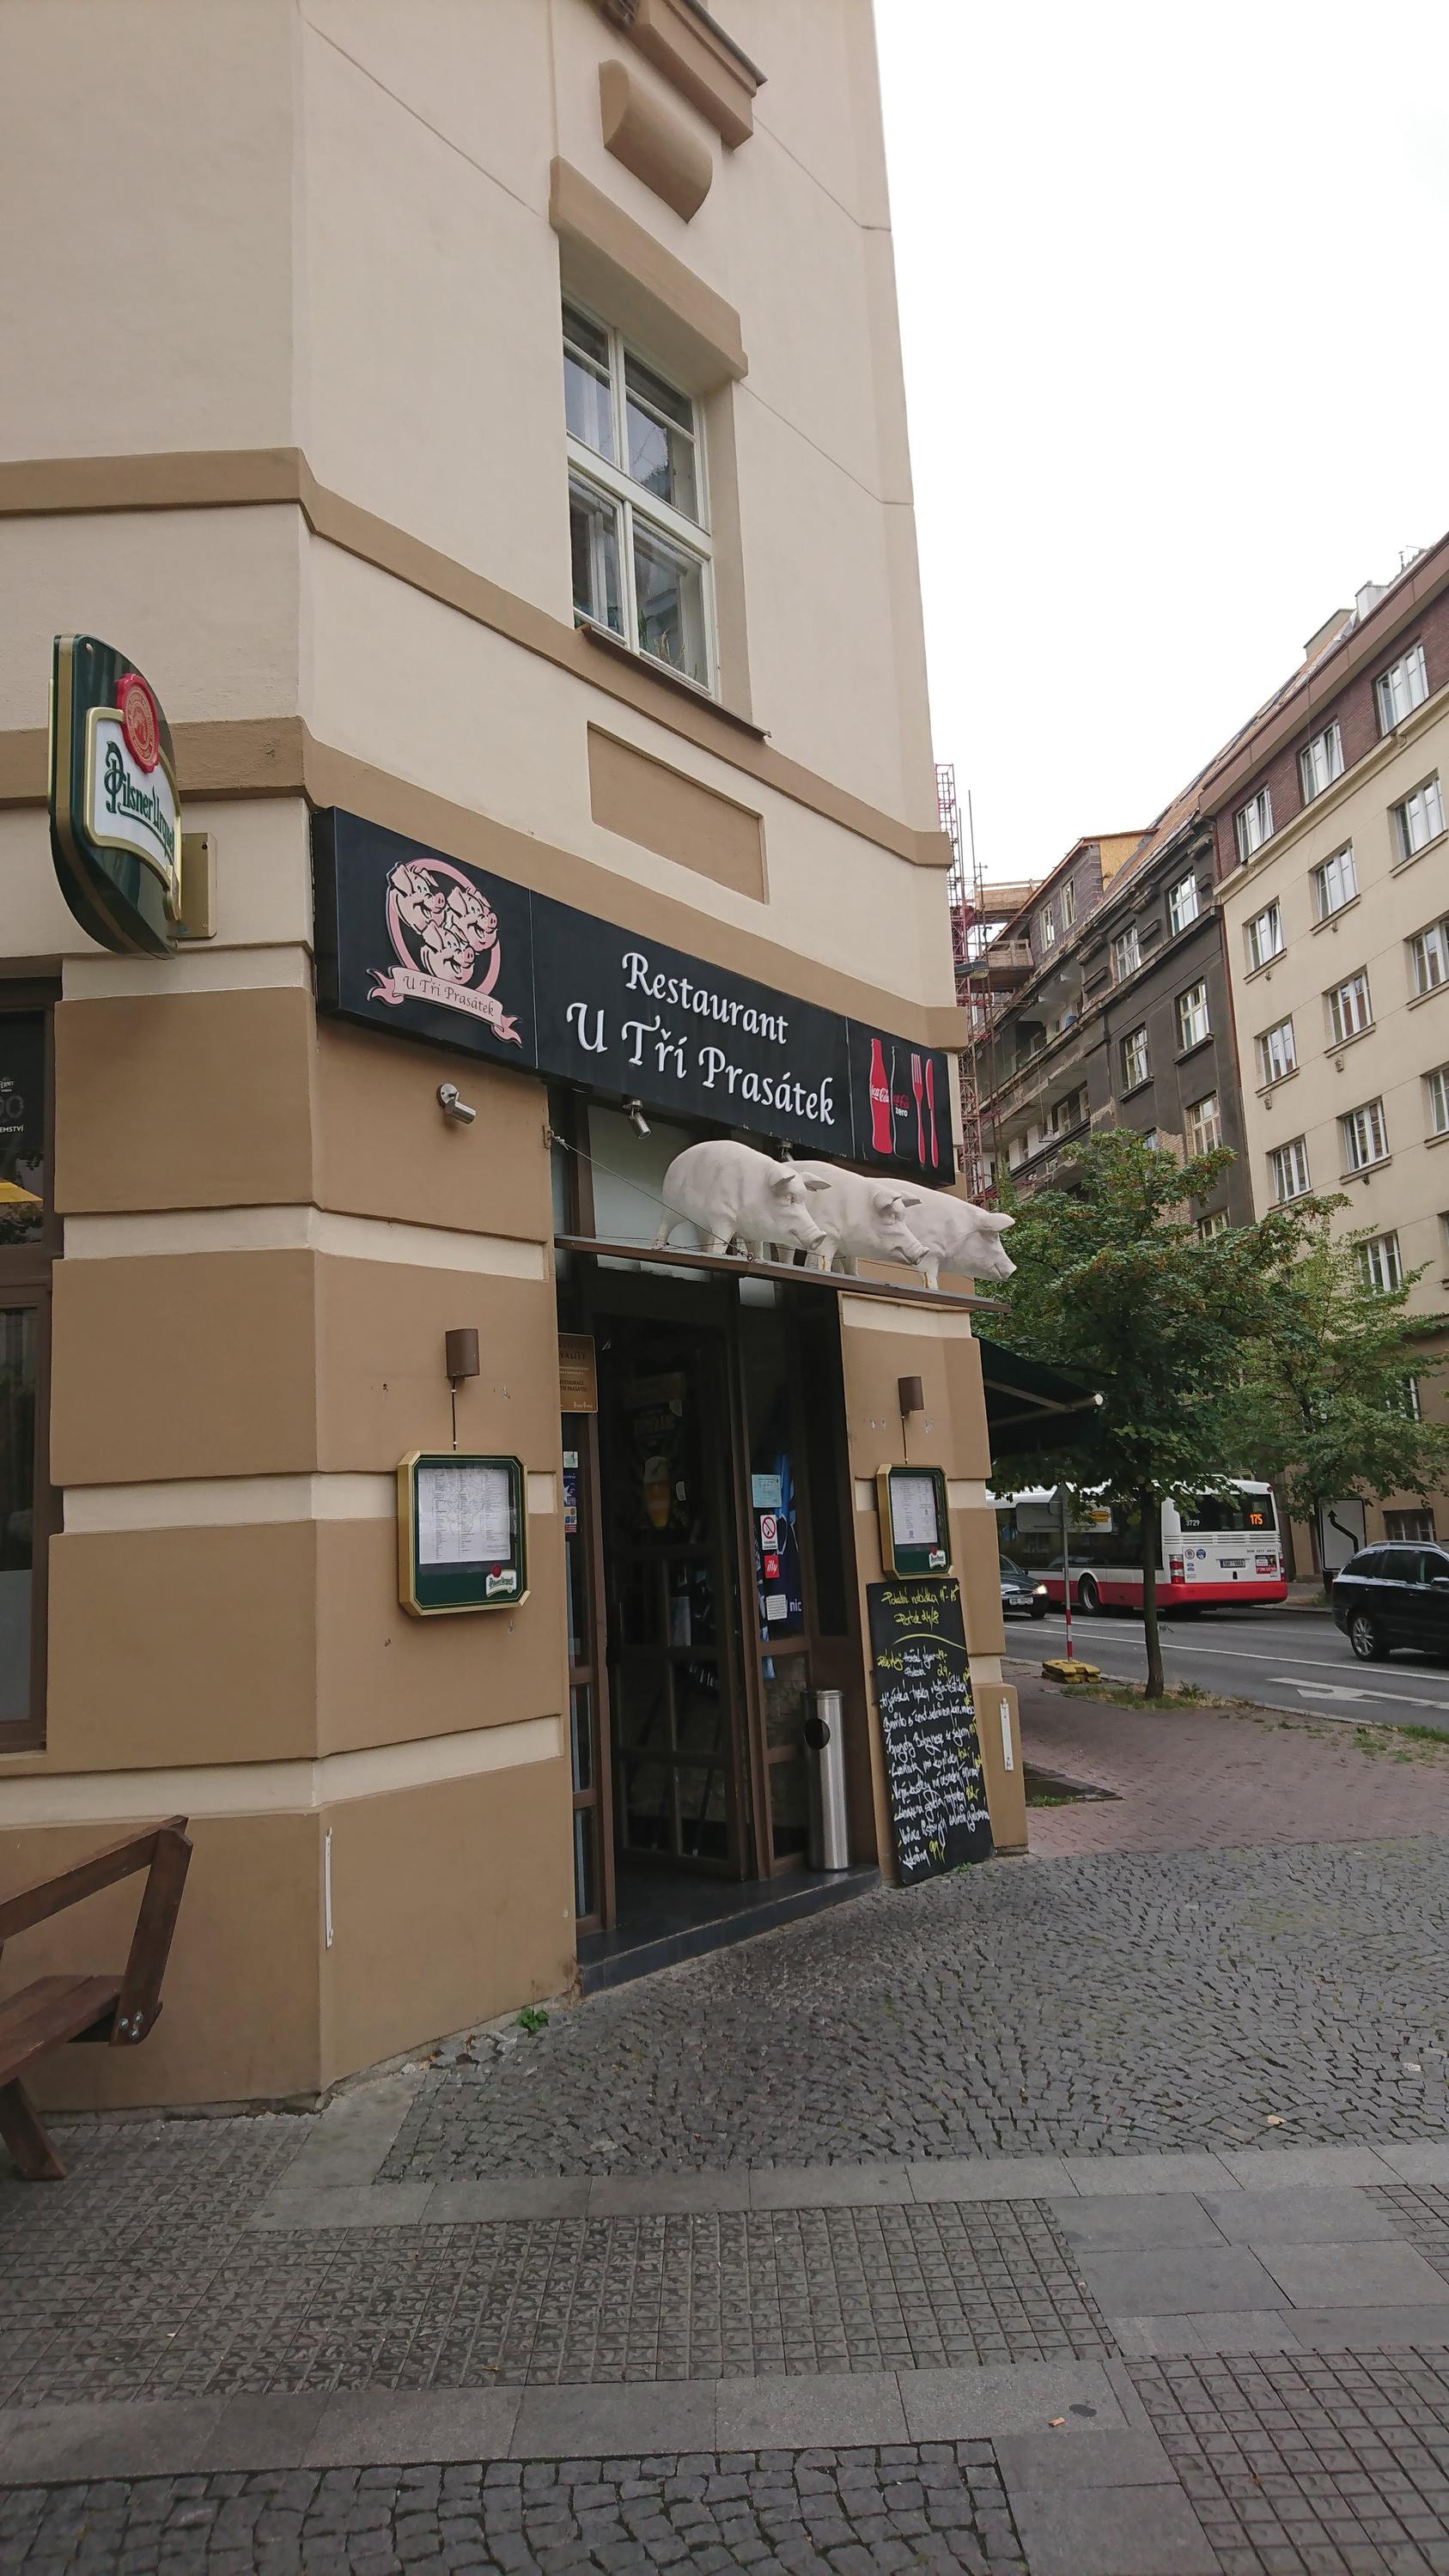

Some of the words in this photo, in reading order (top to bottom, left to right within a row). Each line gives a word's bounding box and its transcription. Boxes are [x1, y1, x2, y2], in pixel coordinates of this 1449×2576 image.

[104, 741, 153, 821] Pilsner
[403, 975, 416, 990] U
[419, 978, 441, 997] Tří
[444, 986, 495, 1017] Prasátek
[622, 952, 789, 1045] Restaurant
[566, 1002, 608, 1054] U
[621, 1015, 688, 1079] Tří
[697, 1047, 836, 1127] Prasátek
[895, 1107, 909, 1117] zero
[1250, 1513, 1263, 1525] 175
[766, 1559, 778, 1574] illy
[789, 1599, 802, 1613] nic
